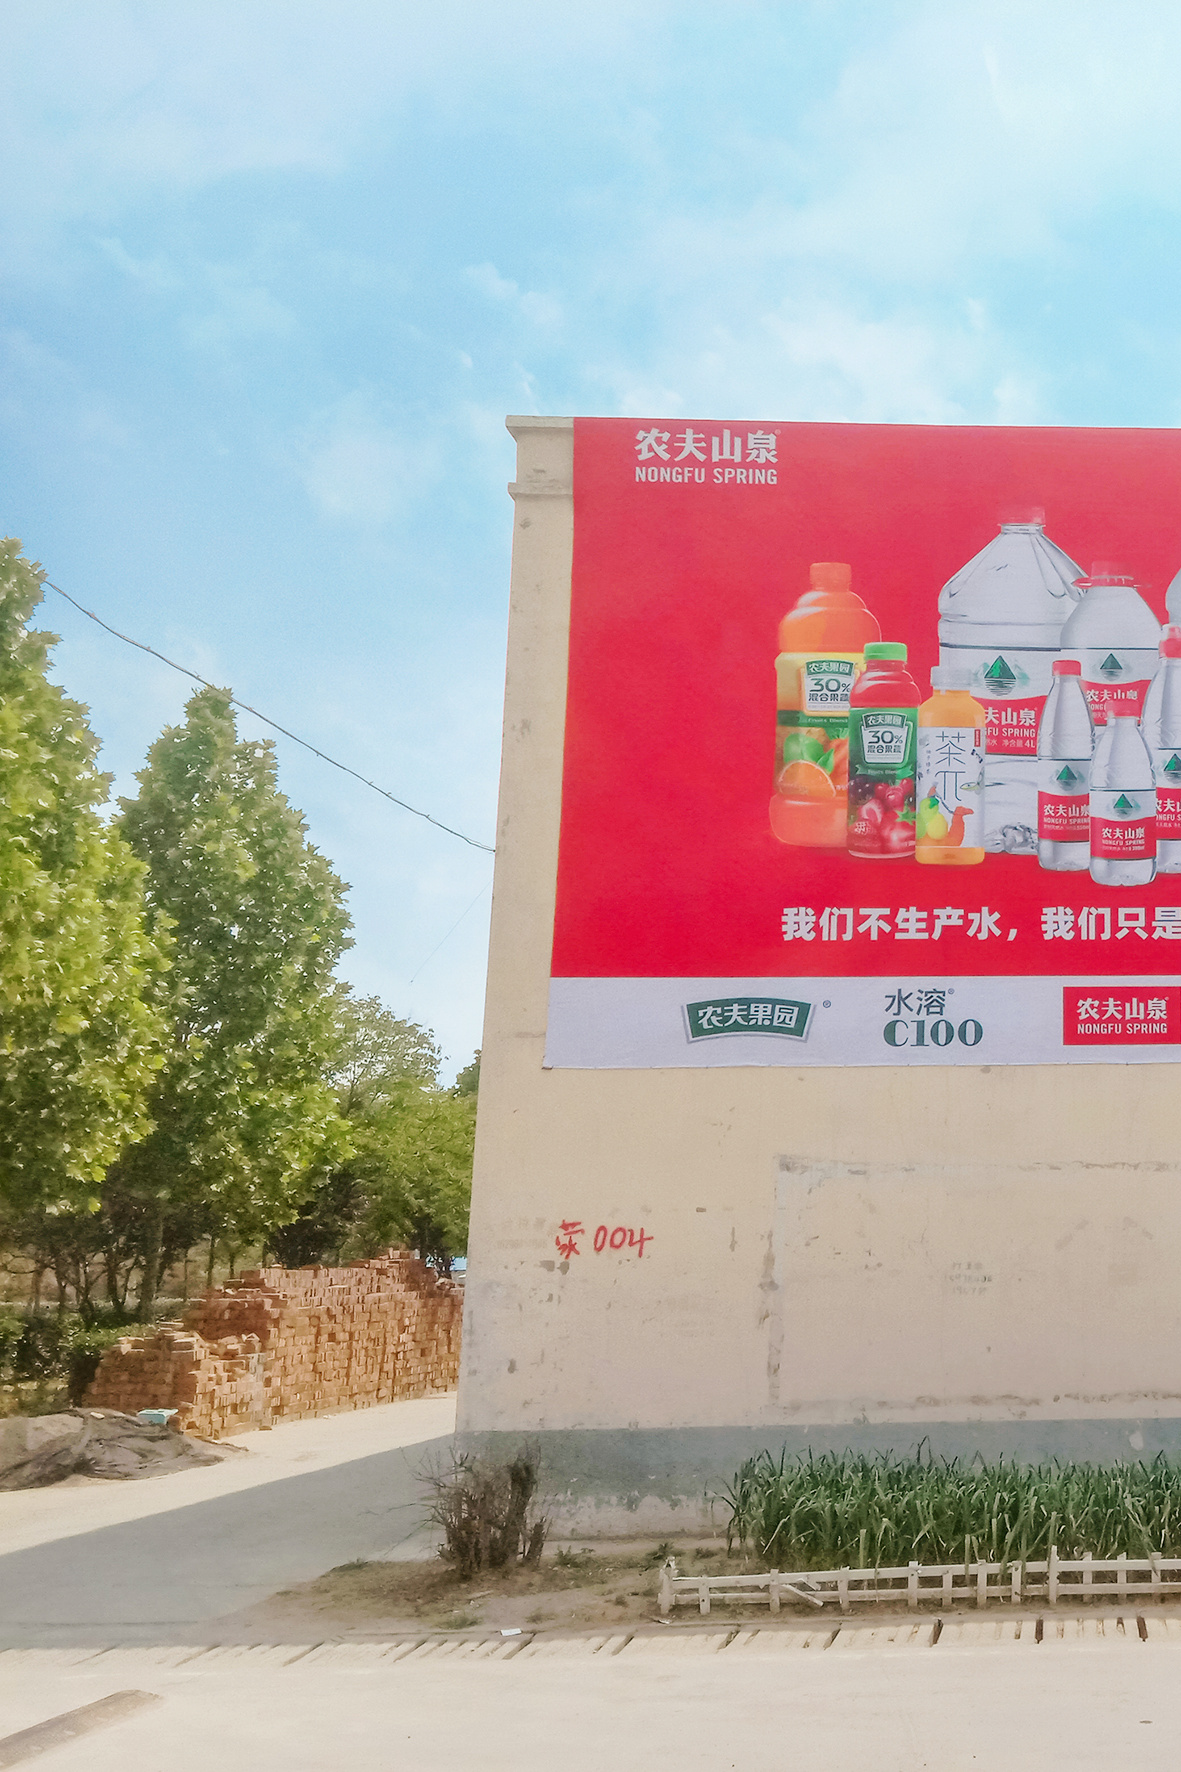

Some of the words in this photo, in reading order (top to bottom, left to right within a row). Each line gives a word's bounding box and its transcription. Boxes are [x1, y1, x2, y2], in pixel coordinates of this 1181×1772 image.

[634, 427, 778, 464] 农夫山泉
[635, 466, 705, 483] NONGFU
[713, 468, 778, 485] SPRING
[809, 677, 851, 692] 30%
[868, 730, 903, 745] 30%
[1002, 727, 1036, 738] SPRING
[1101, 827, 1146, 840] 农夫山泉
[884, 988, 947, 1017] 水溶
[1076, 997, 1168, 1020] 农夫山泉
[697, 1002, 799, 1030] 农夫果园
[883, 1018, 984, 1047] C100
[1077, 1023, 1122, 1035] NONGFU
[1126, 1022, 1168, 1034] SPRING
[593, 1225, 655, 1258] 004
